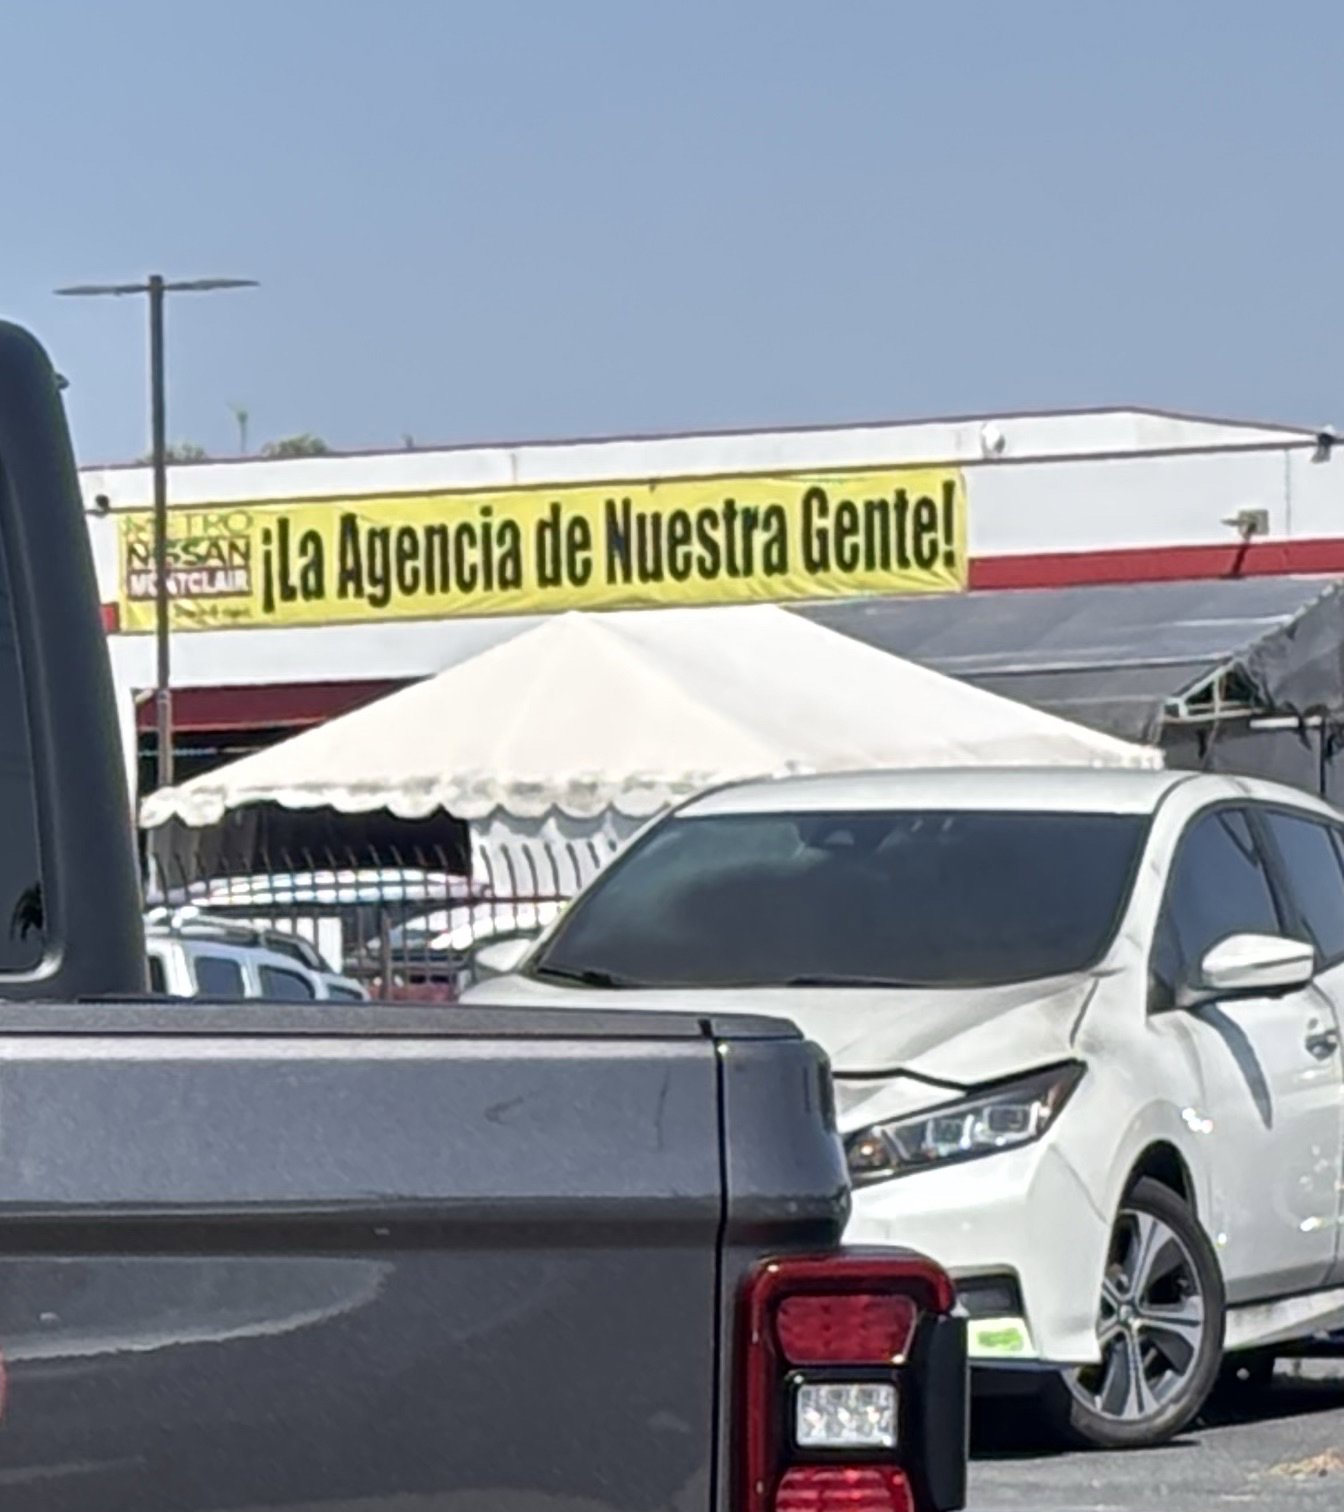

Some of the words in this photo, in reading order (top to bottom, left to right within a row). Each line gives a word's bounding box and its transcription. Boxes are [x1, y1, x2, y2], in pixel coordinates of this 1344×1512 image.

[123, 509, 254, 538] MTRO
[128, 536, 250, 568] NSSAN
[261, 516, 326, 615] ¡La
[336, 504, 522, 609] Agencia
[535, 501, 593, 589] de
[604, 496, 789, 585] Nuestra
[800, 479, 956, 576] Gente!
